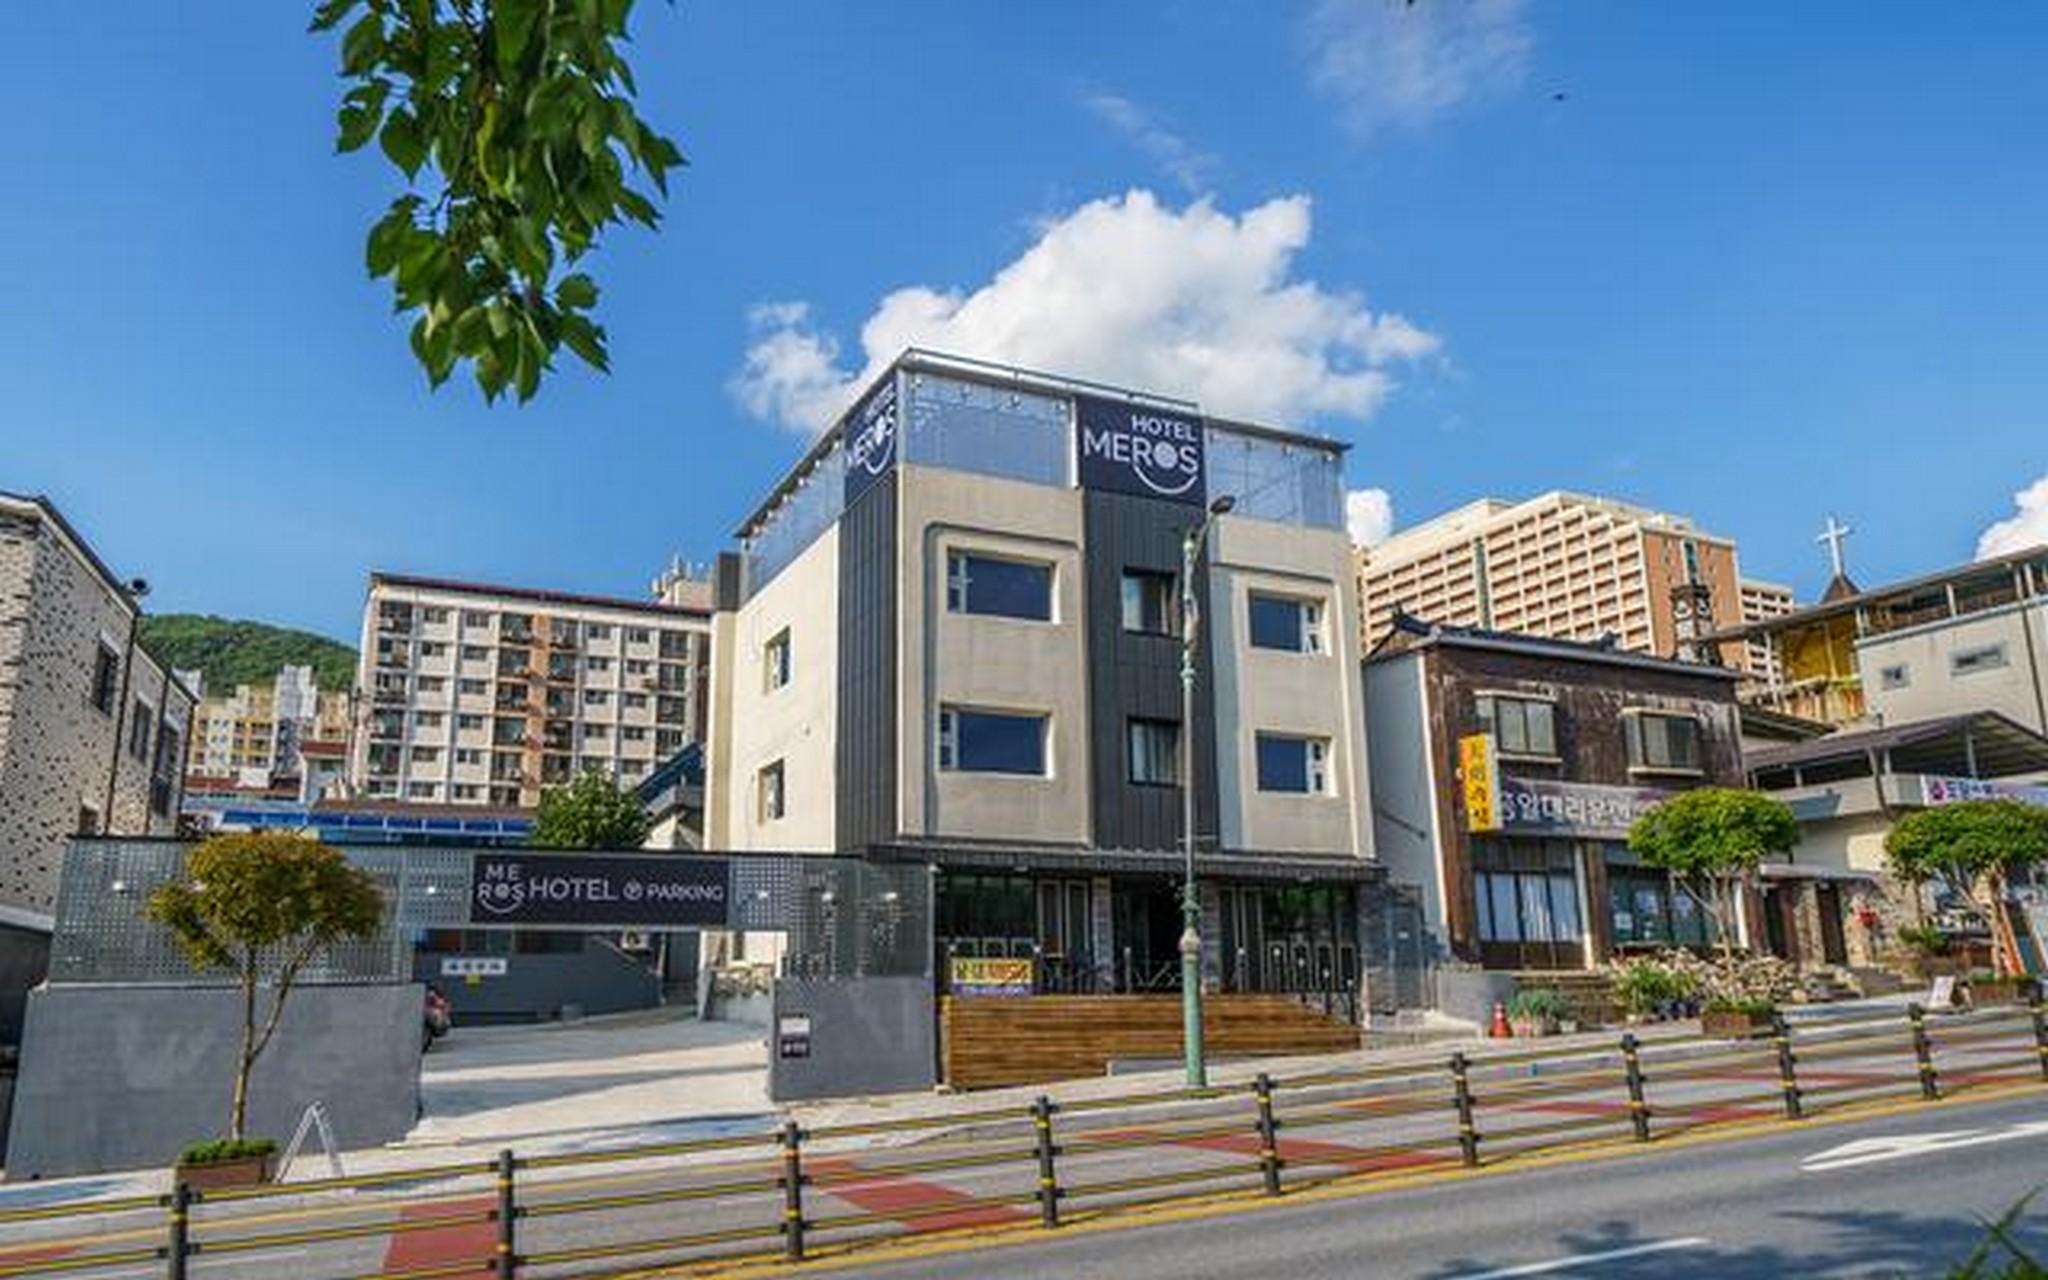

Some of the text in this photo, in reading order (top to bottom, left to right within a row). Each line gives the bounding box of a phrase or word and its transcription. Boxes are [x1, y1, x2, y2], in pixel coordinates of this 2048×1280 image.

[1131, 414, 1197, 442] HOTEL
[1083, 426, 1198, 474] MEROS
[485, 863, 521, 881] ME
[529, 877, 618, 900] HOTEL
[647, 883, 723, 900] PARKING
